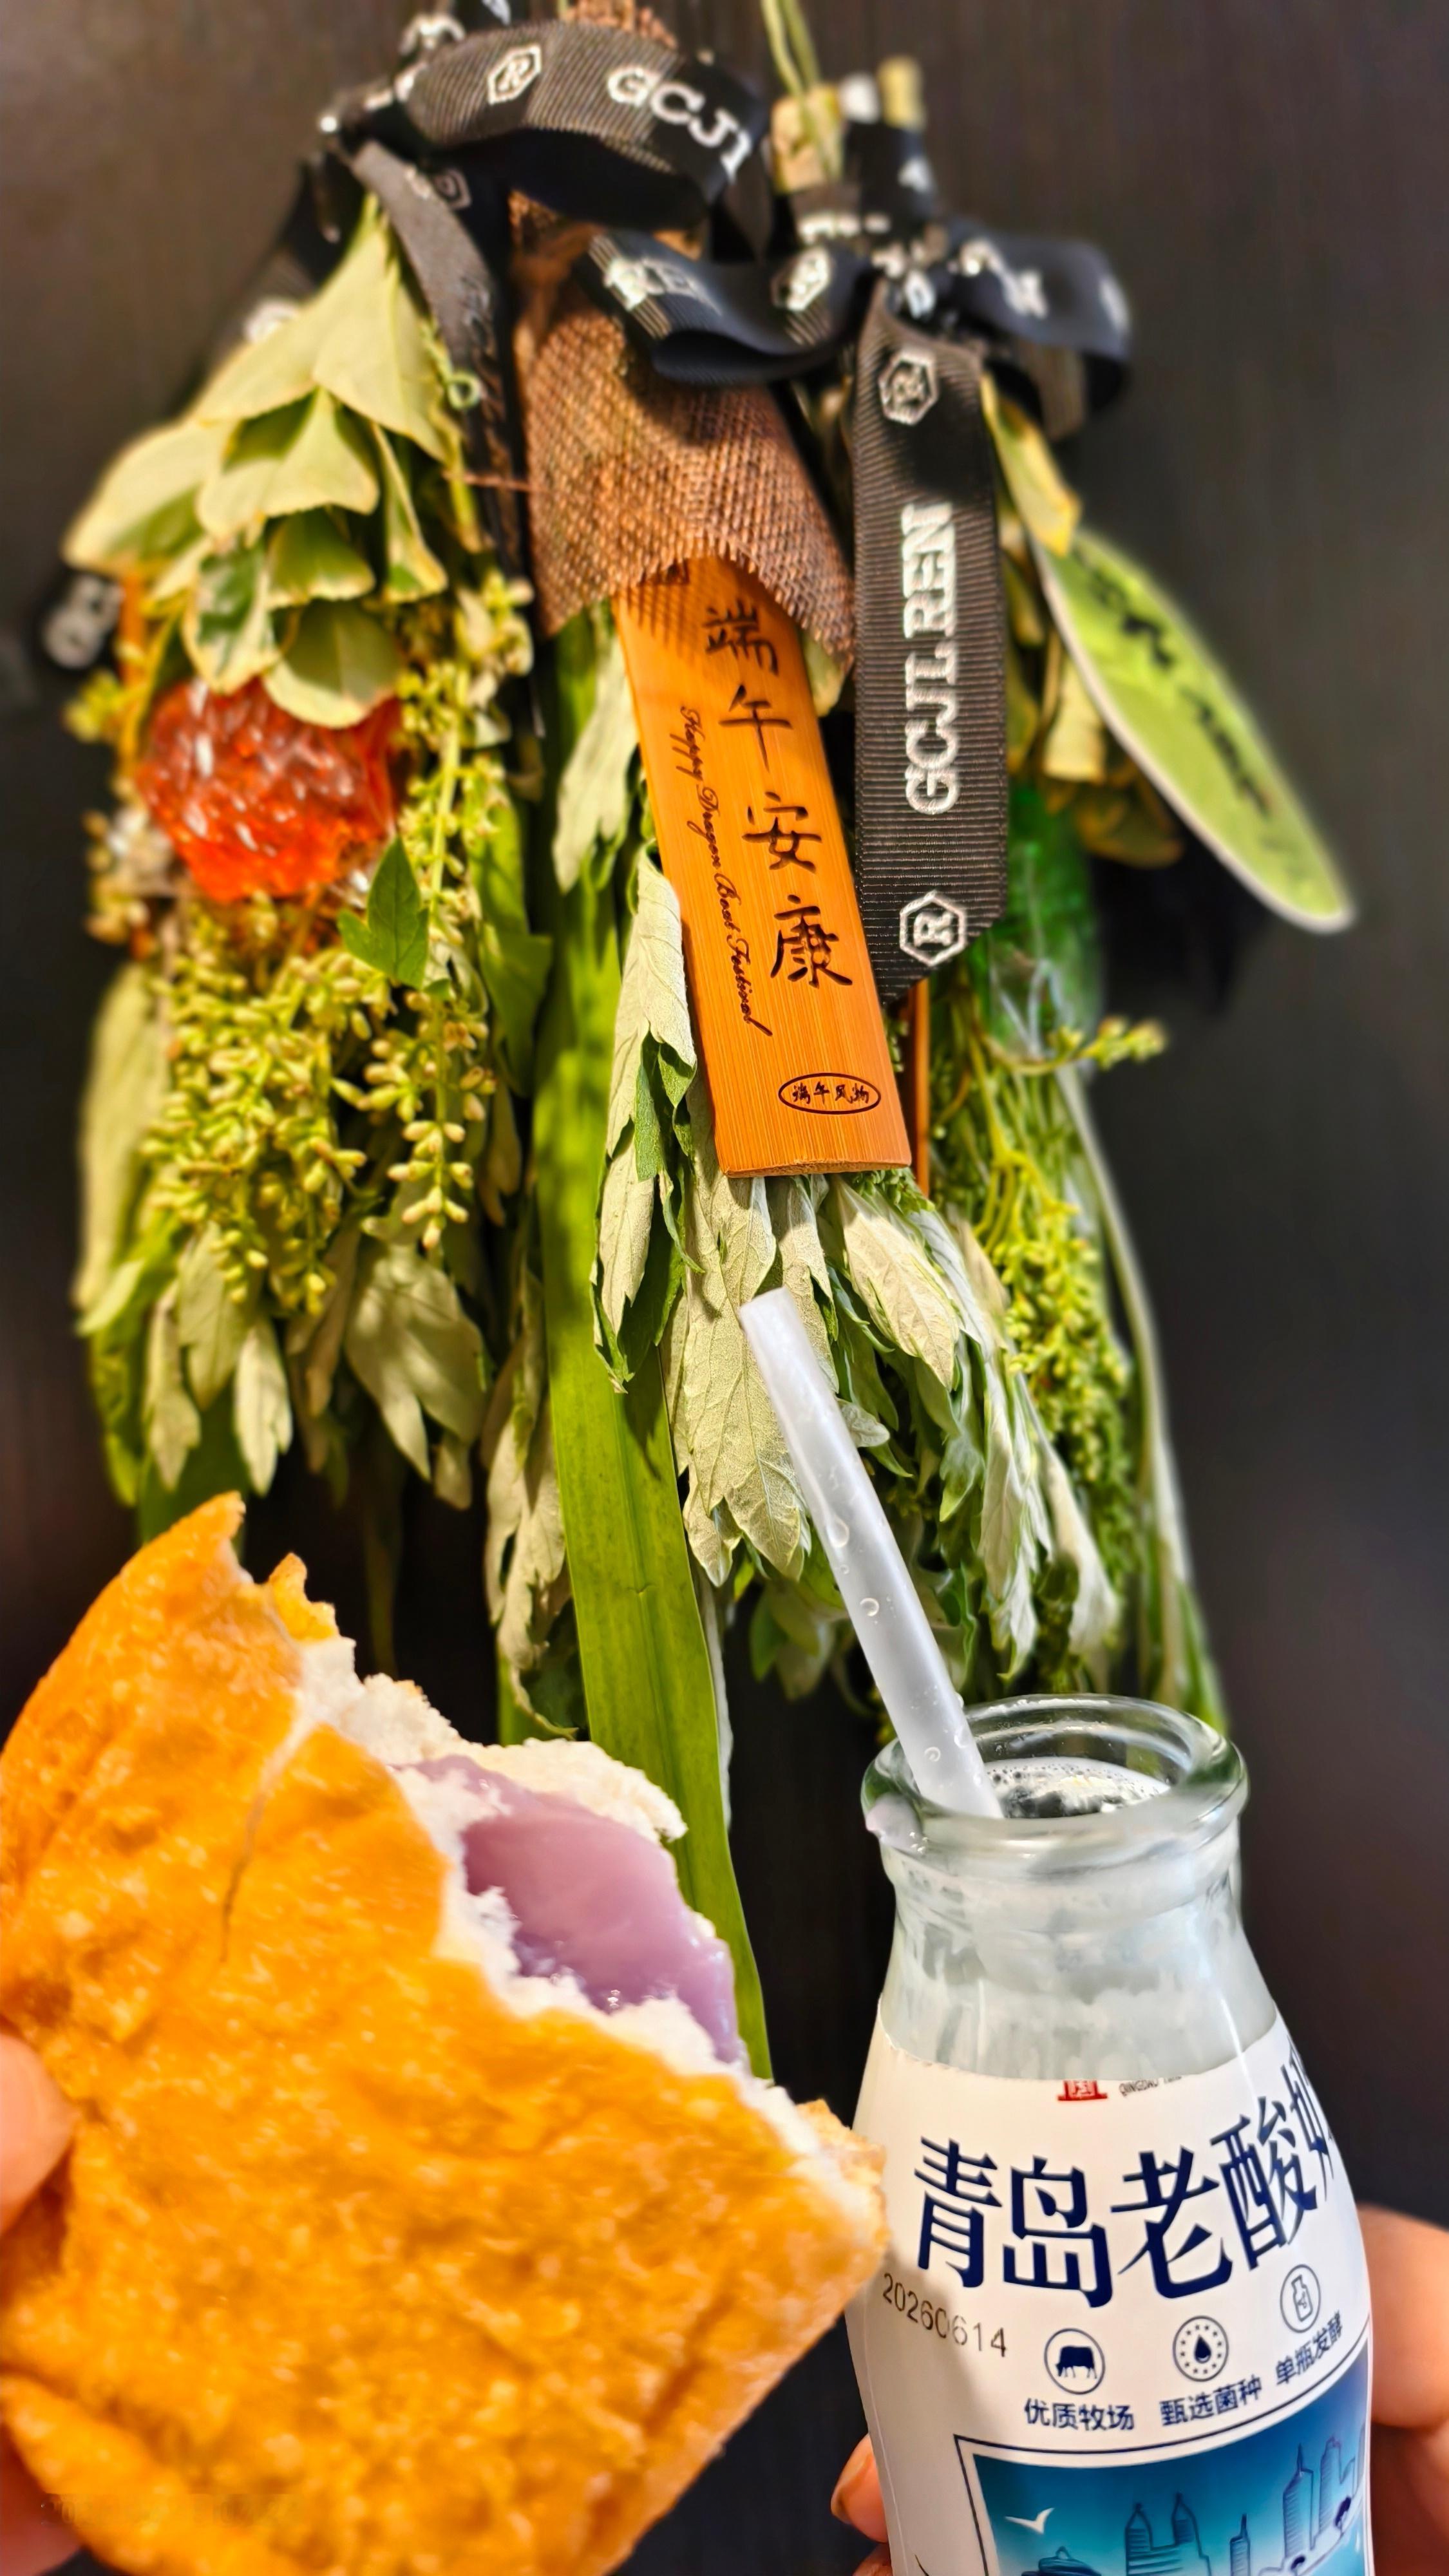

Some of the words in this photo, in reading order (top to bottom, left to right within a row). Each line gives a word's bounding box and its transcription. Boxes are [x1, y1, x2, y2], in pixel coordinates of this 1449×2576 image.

[669, 706, 706, 782] Happy
[687, 784, 722, 869] Dragon
[702, 597, 853, 989] 端午安康
[714, 873, 742, 933] Boat
[726, 934, 773, 1036] Festival
[791, 1081, 869, 1104] 端午风物
[882, 2272, 1008, 2358] 20260614
[1275, 2309, 1343, 2385] 单瓶发酵
[1023, 2397, 1135, 2431] 优质牧场
[1159, 2374, 1263, 2427] 甄选菌种
